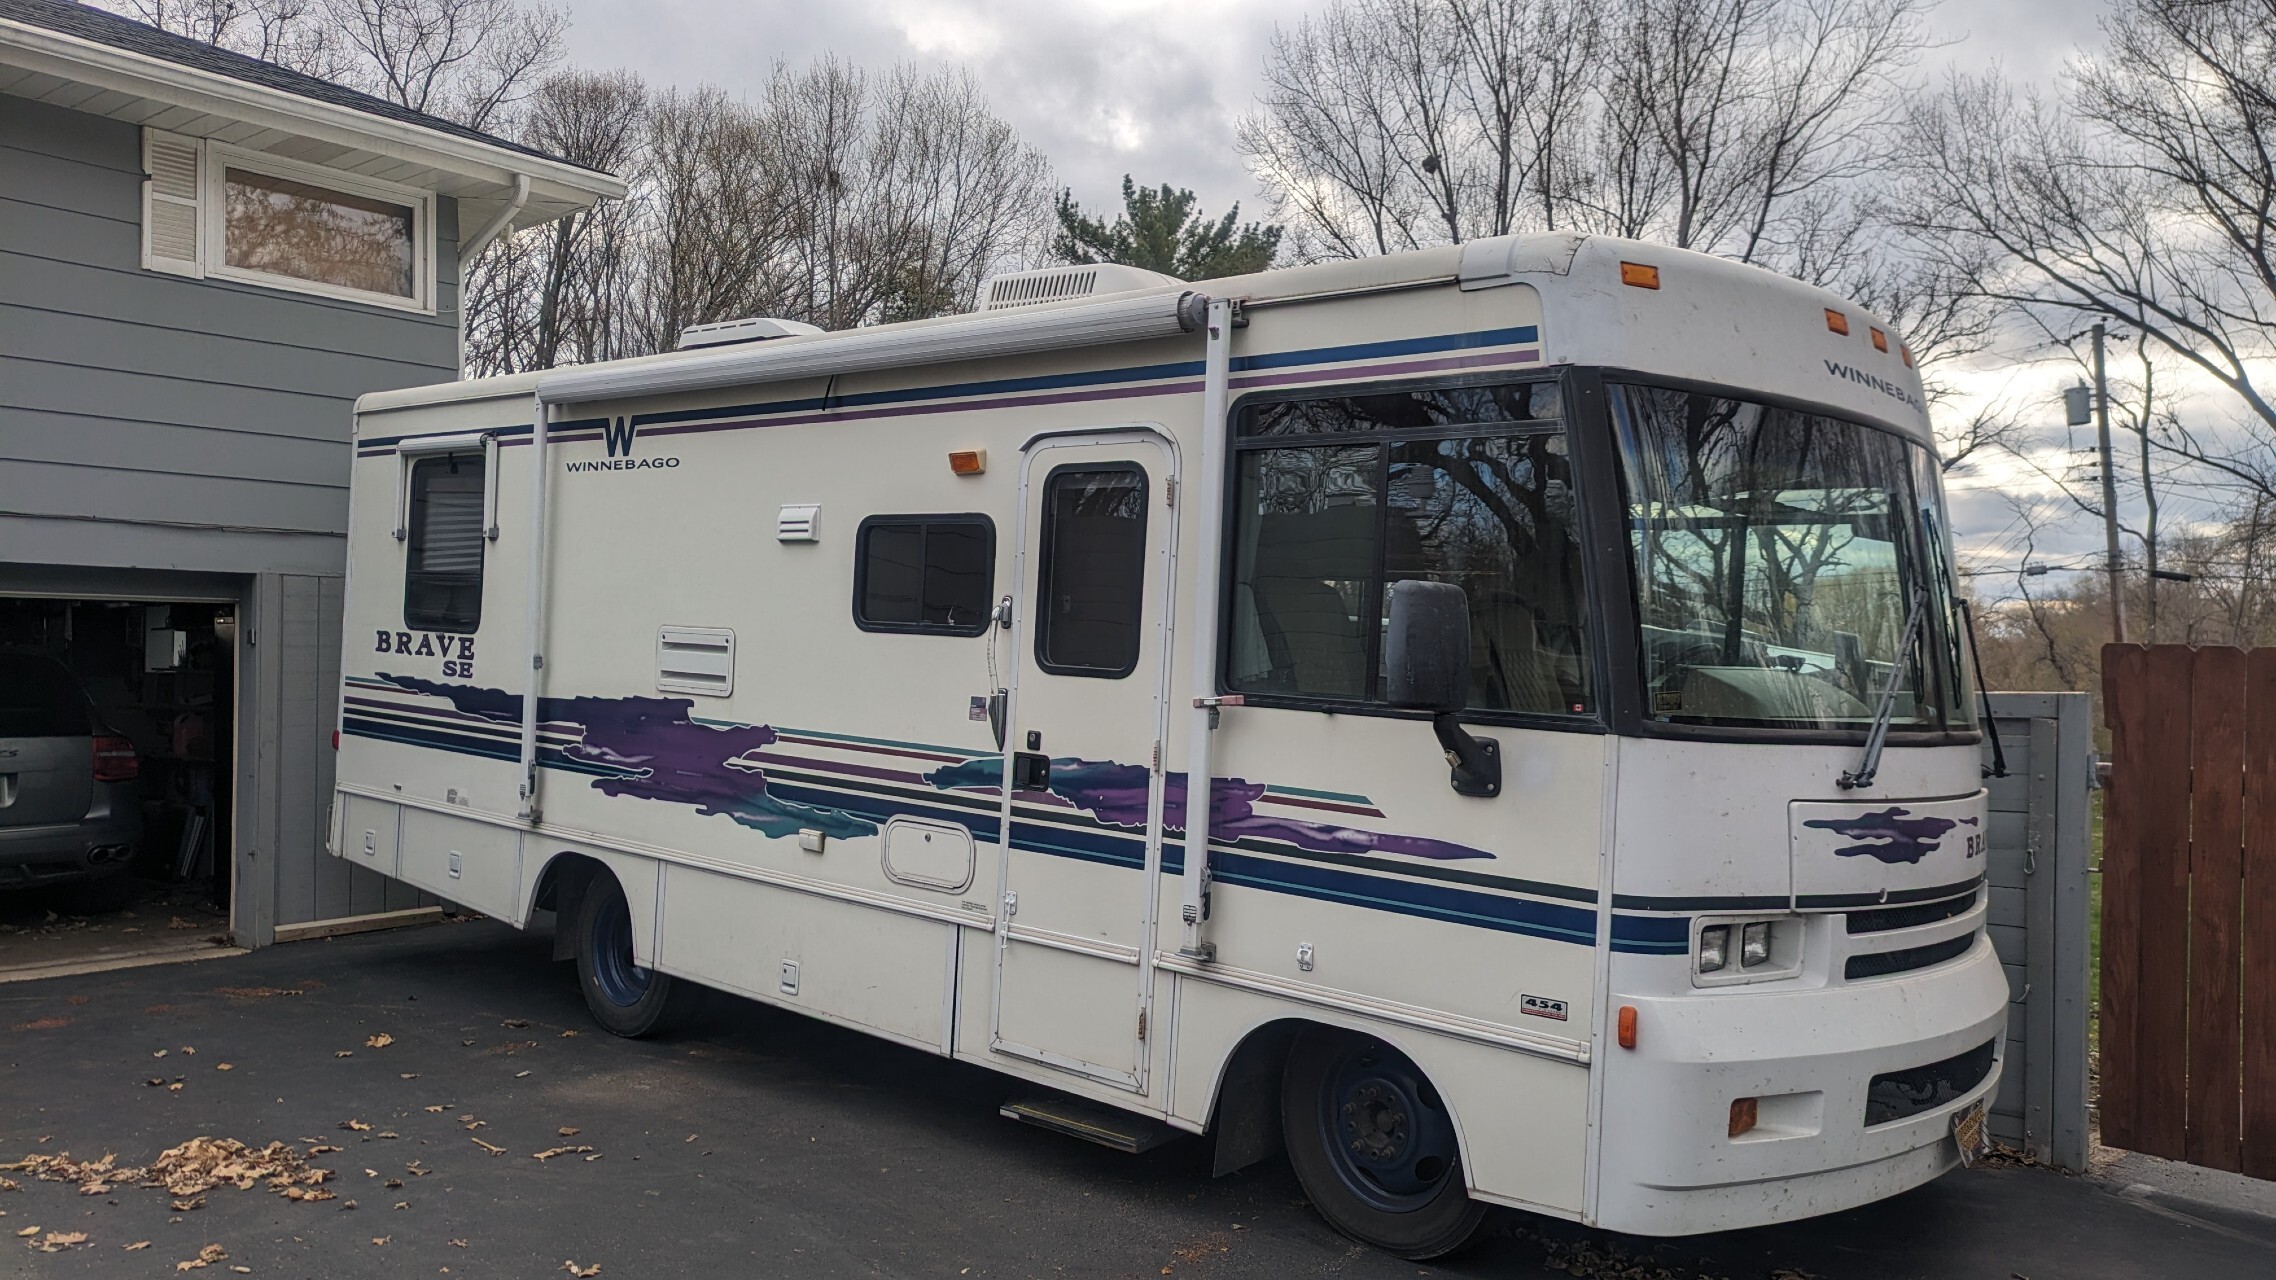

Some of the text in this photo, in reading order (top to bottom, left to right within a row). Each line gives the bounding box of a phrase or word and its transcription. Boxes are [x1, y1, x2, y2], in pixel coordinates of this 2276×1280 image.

[1824, 359, 1923, 413] WINNEBA
[566, 457, 680, 472] WINNEBAGO
[375, 630, 475, 660] BRAVE
[442, 660, 473, 679] SE
[1525, 998, 1562, 1012] 454
